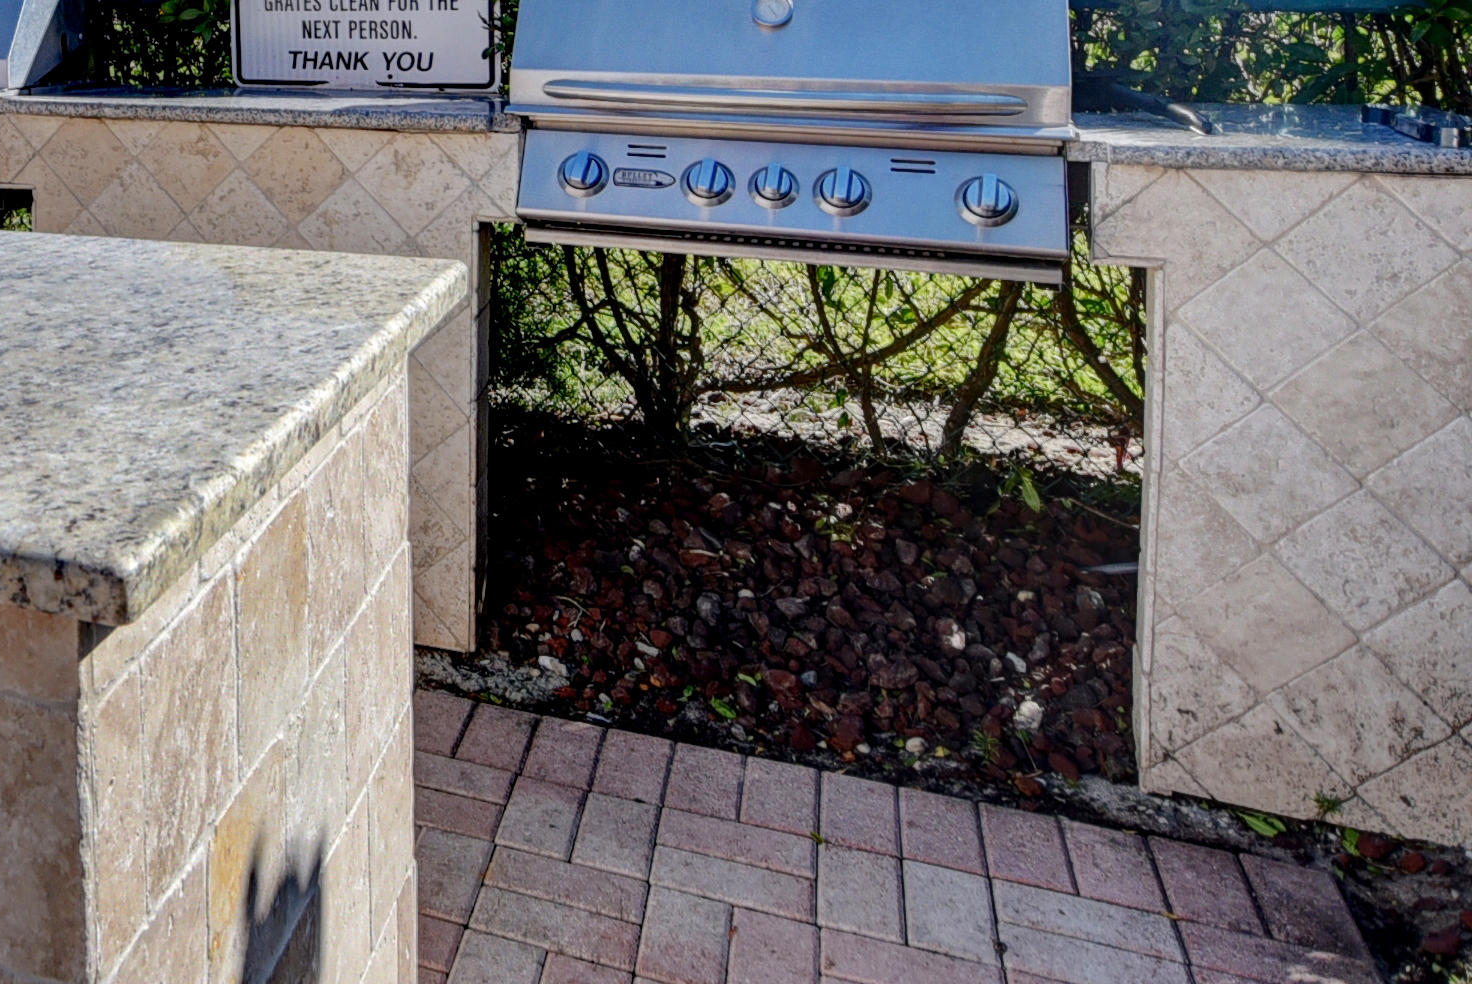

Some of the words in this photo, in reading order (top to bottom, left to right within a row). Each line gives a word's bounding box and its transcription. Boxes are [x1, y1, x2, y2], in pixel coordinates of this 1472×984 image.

[302, 21, 341, 39] NEXT
[349, 20, 417, 39] PERSON.
[289, 51, 369, 70] THANK
[383, 52, 433, 71] YOU
